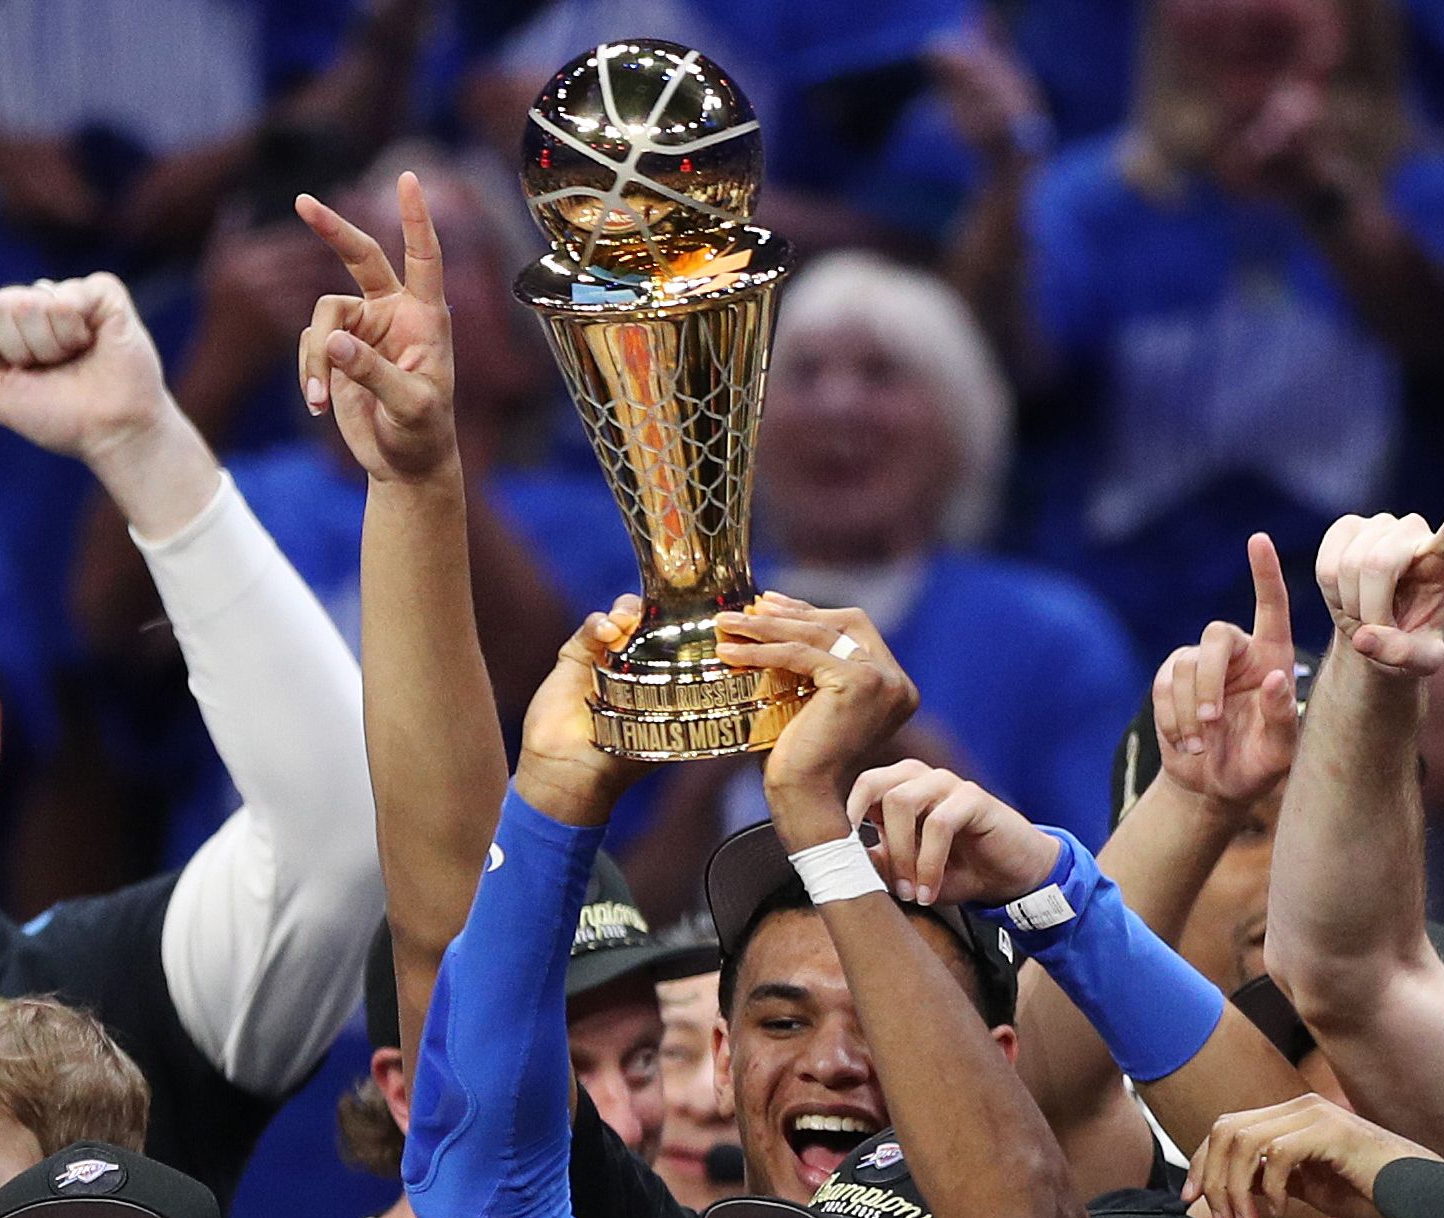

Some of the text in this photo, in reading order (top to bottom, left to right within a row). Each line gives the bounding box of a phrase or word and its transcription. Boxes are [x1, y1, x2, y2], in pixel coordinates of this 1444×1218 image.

[633, 686, 672, 710] BILL
[674, 675, 754, 709] RUSSELL
[623, 720, 685, 750] FINALS
[688, 713, 744, 749] MOST
